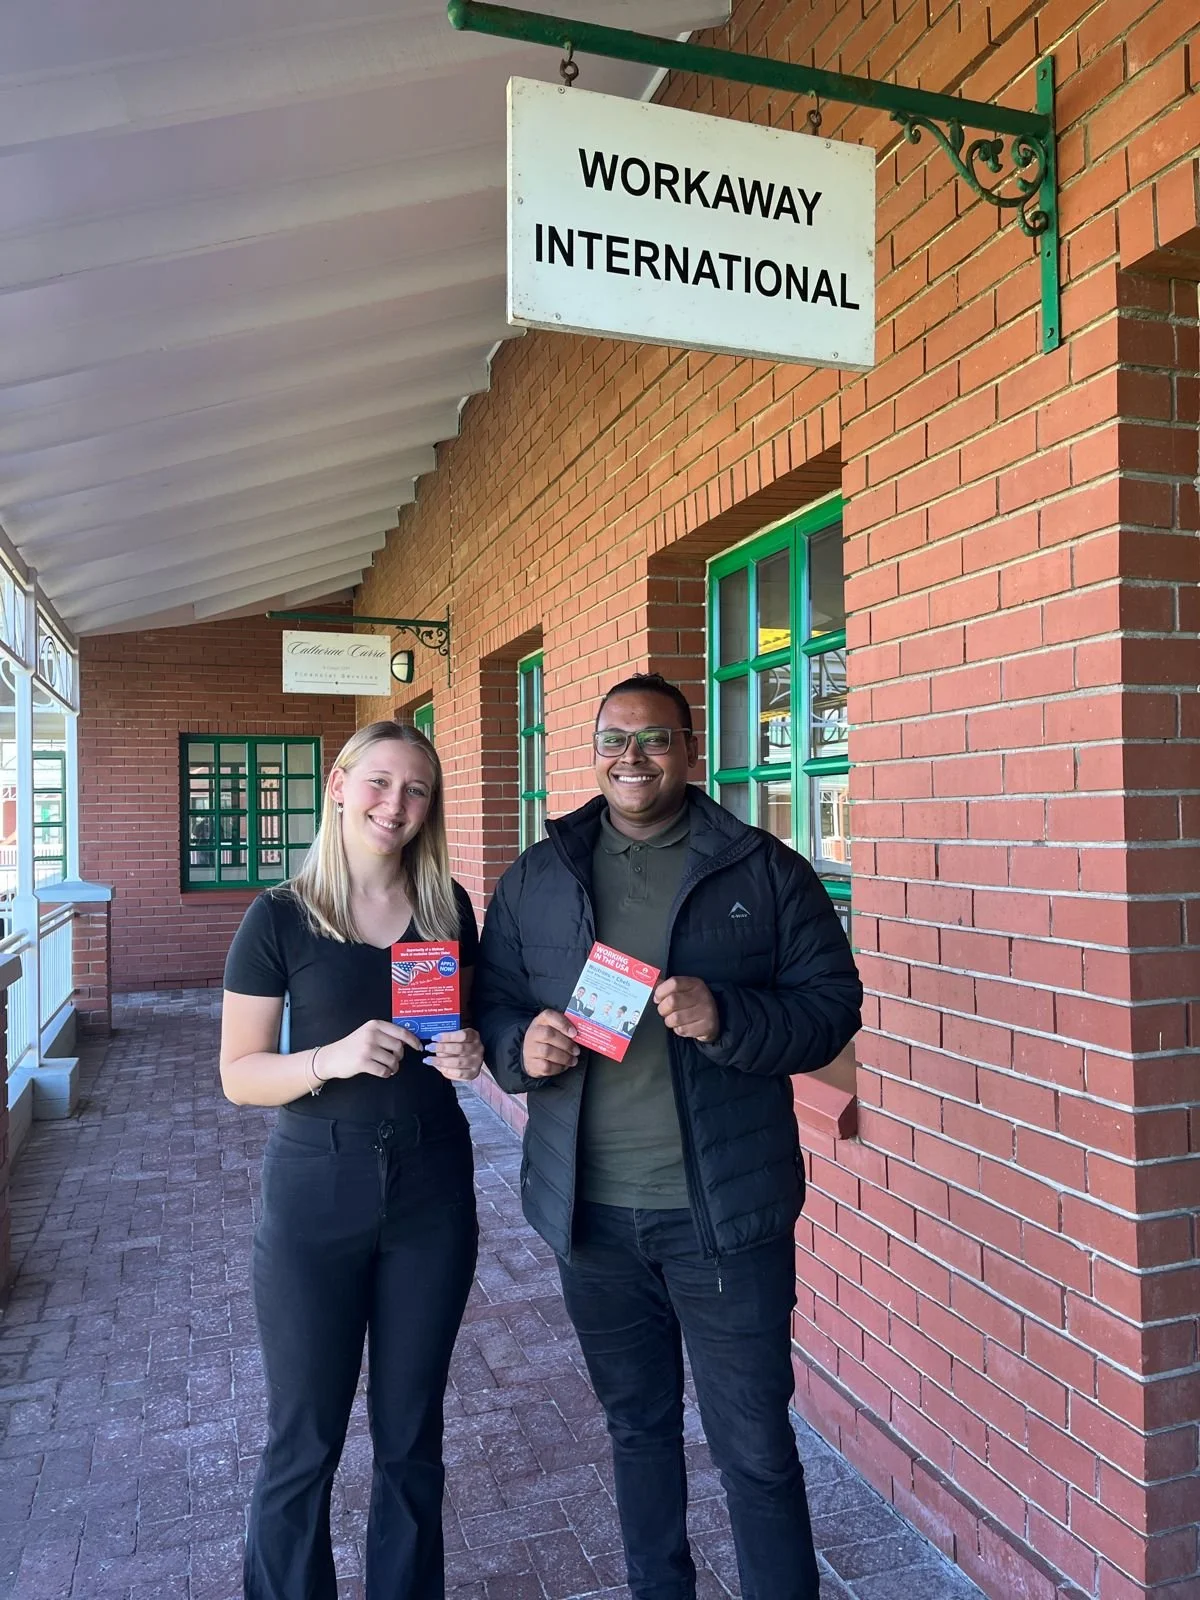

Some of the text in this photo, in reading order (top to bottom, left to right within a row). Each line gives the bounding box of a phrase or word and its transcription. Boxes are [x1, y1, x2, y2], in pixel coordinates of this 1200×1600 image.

[578, 147, 823, 227] WORKAWAY
[535, 223, 860, 310] INTERNATIONAL
[287, 641, 387, 657] Catherine Currie
[593, 951, 630, 973] IN THE USA
[596, 945, 629, 965] WORKING
